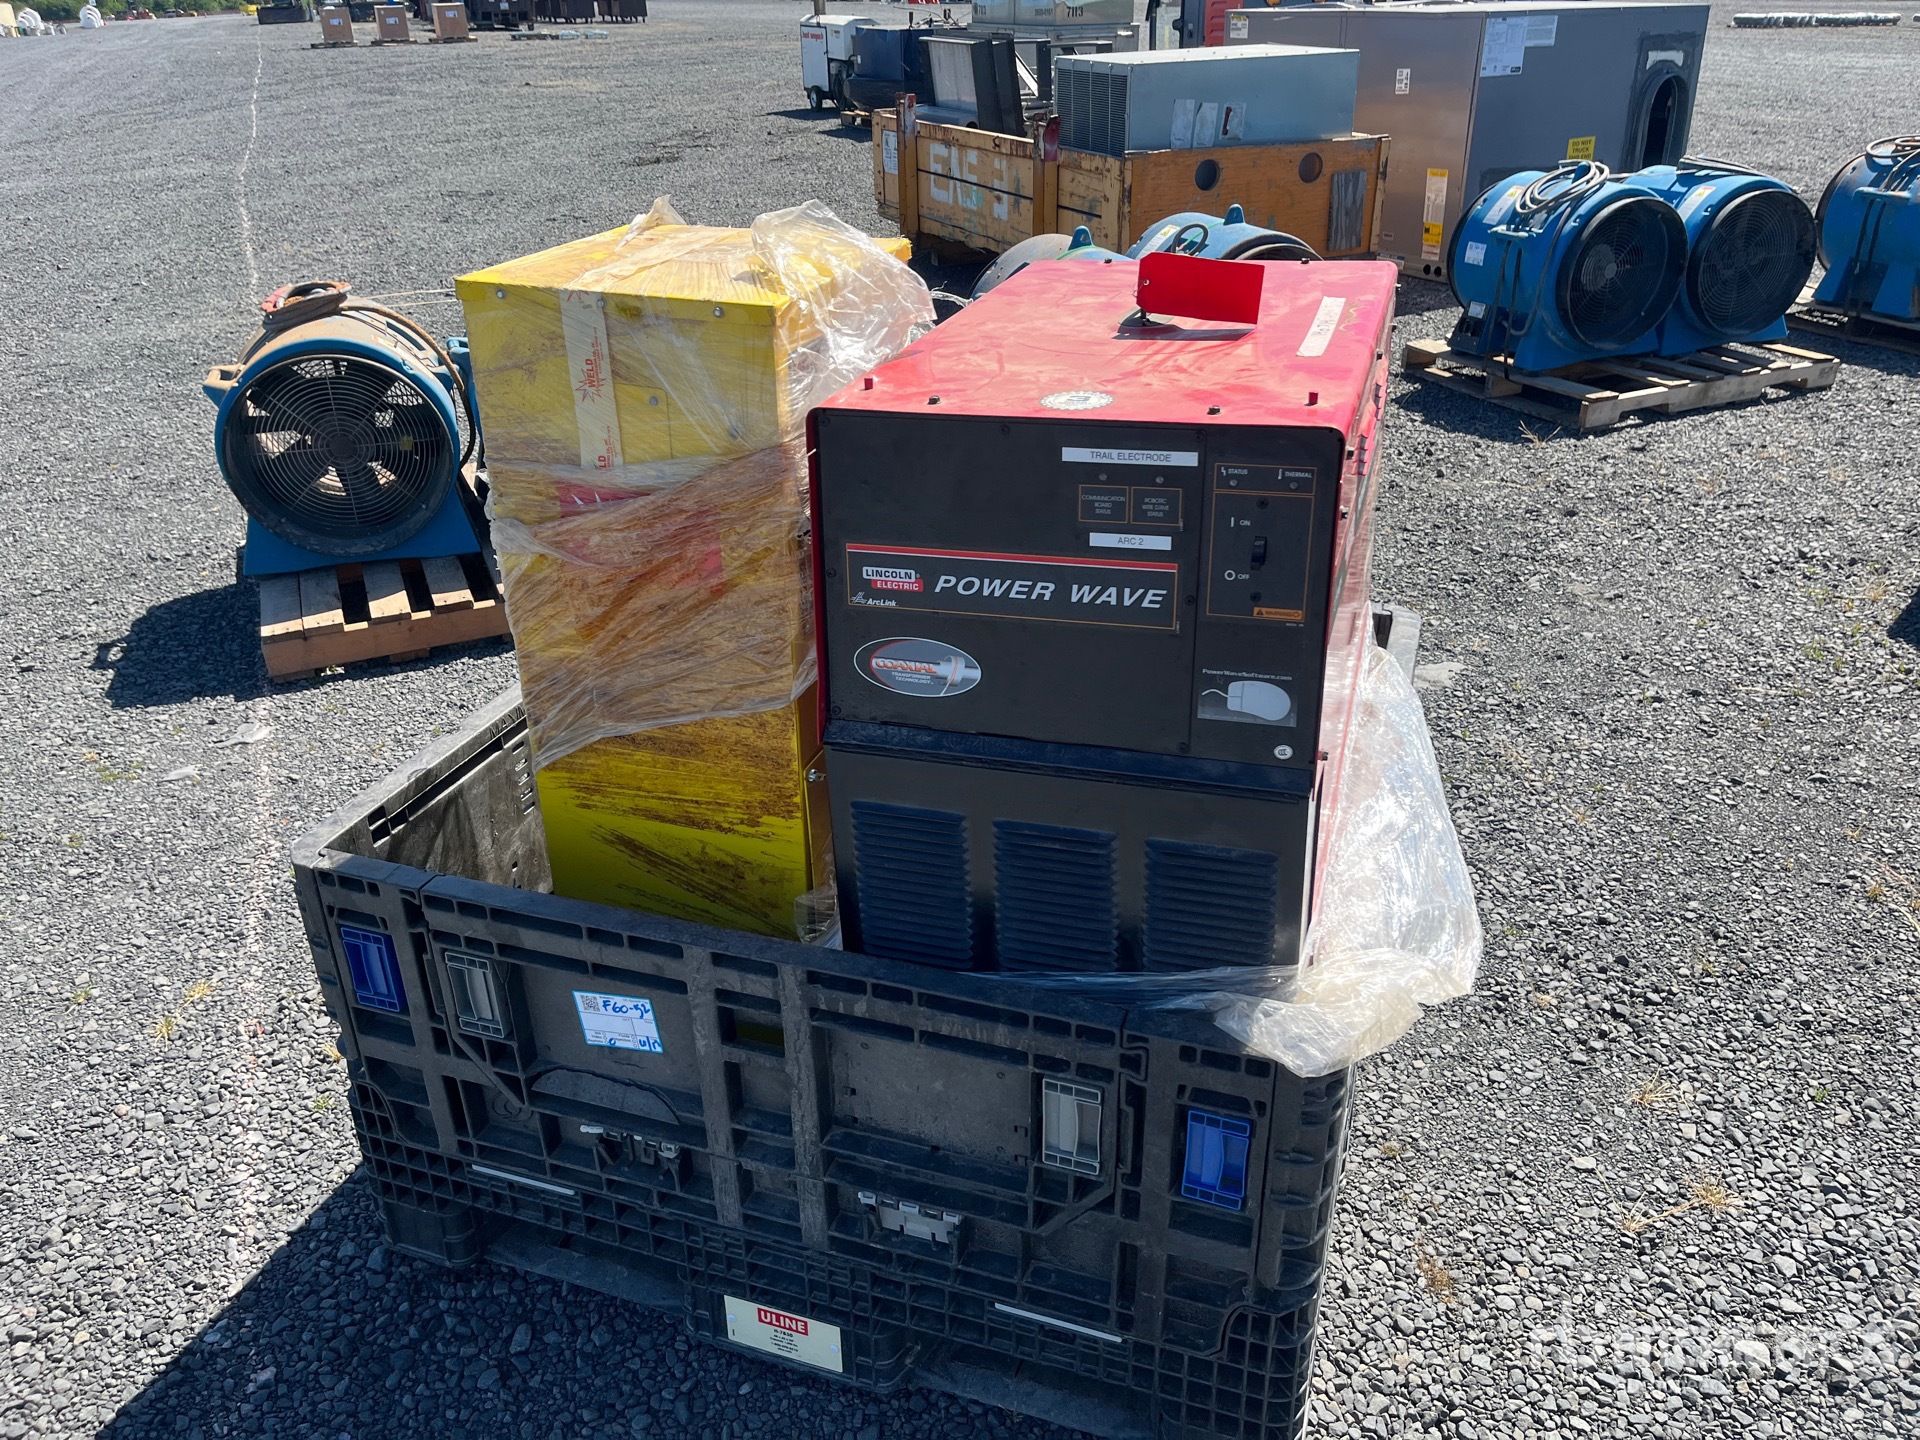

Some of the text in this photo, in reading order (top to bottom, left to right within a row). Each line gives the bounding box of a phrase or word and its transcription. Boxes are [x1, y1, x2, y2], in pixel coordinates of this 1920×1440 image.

[585, 358, 596, 388] WELD
[1090, 451, 1172, 462] TRAIL ELECTRODE
[1081, 494, 1126, 502] COMMUNICATION
[1117, 536, 1144, 546] ARC 2
[865, 568, 913, 580] LINCOLN
[877, 580, 919, 591] ELECTRIC
[934, 575, 1168, 609] POWER WAVE
[866, 598, 897, 607] ArcLink
[875, 658, 937, 675] COAXIAL
[891, 671, 931, 680] TRANSFORMER
[1202, 668, 1293, 681] PowerWaveSoftware.com
[895, 677, 931, 685] TECHNOLOGY
[760, 1310, 806, 1333] ULINE
